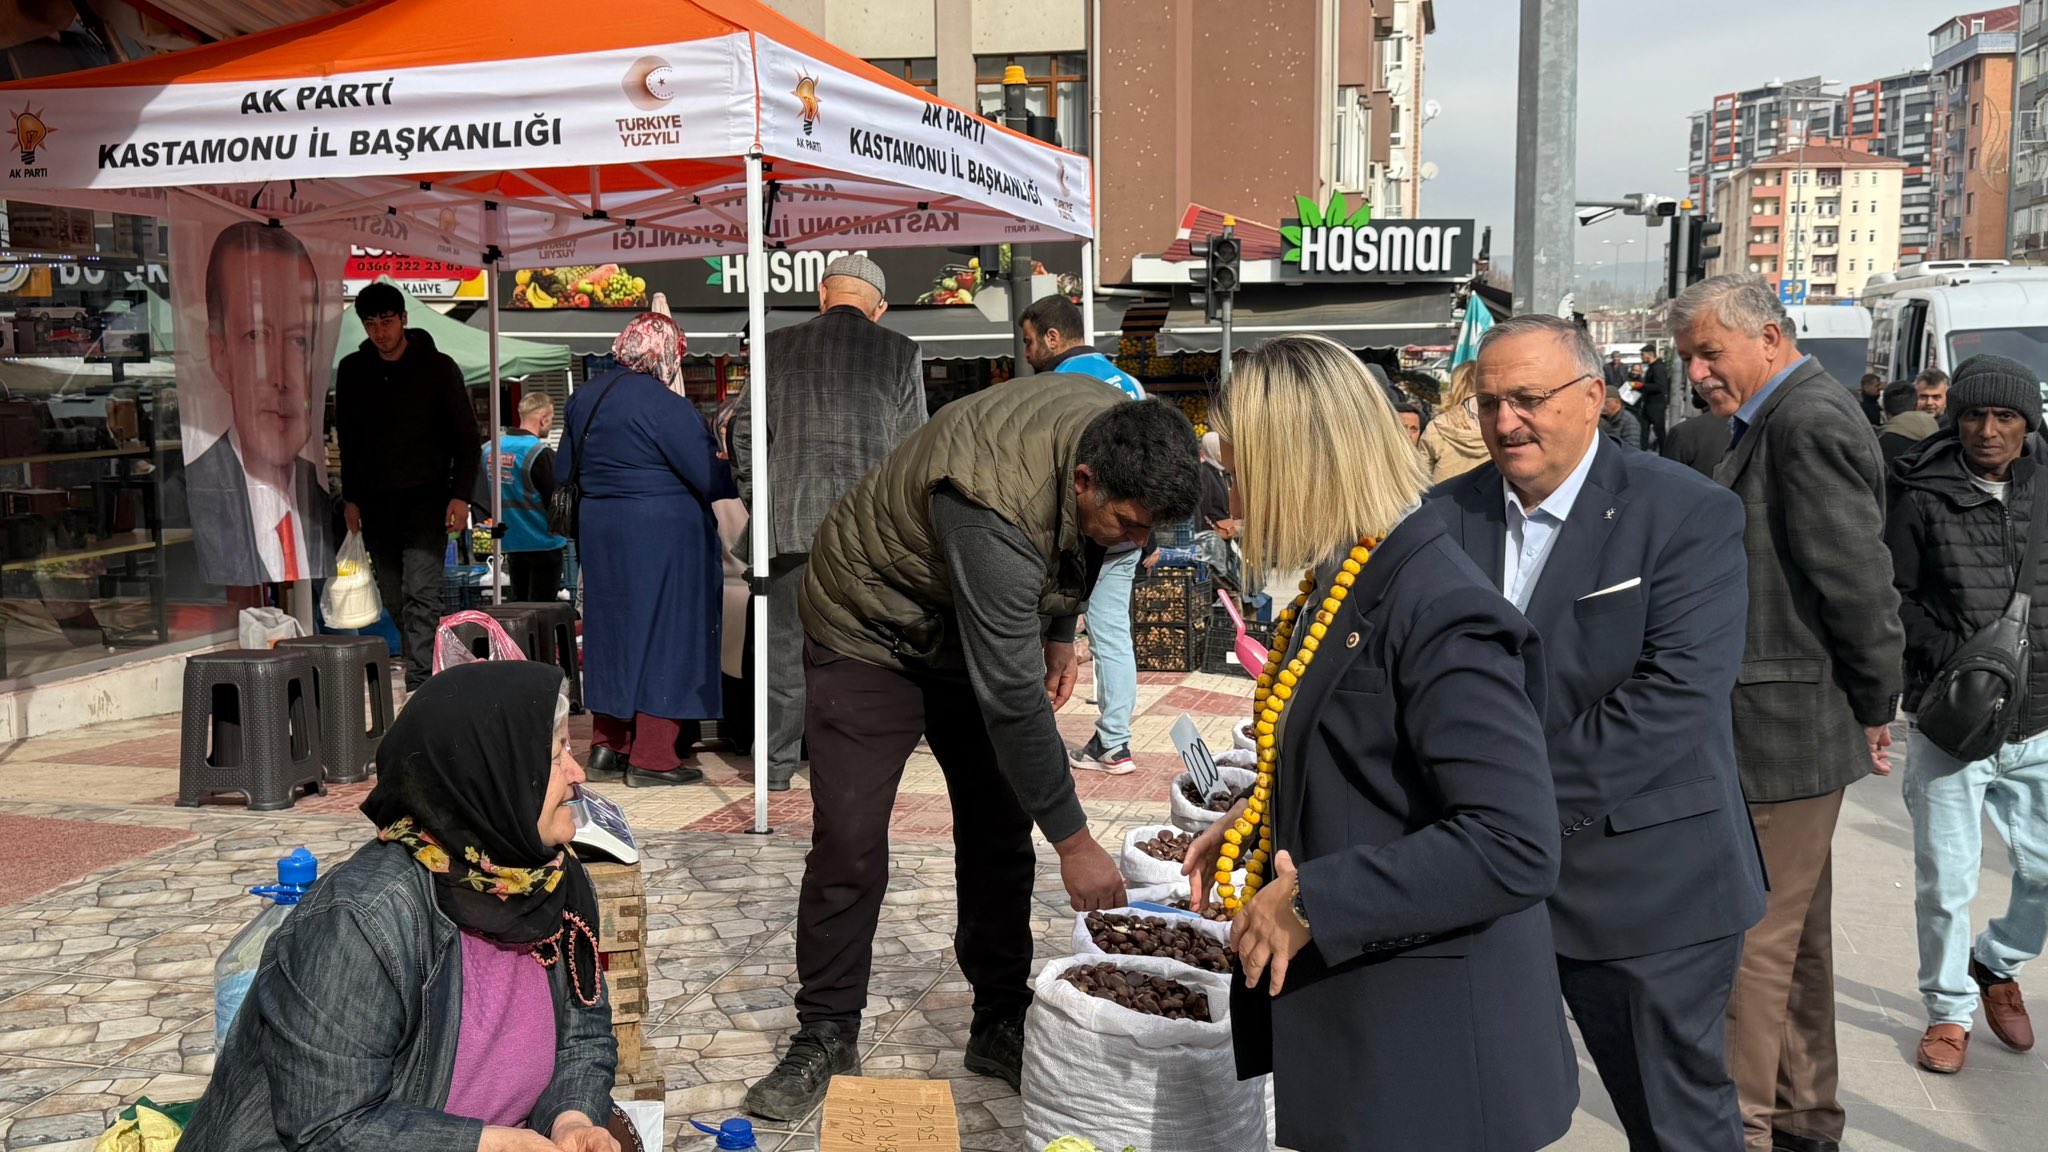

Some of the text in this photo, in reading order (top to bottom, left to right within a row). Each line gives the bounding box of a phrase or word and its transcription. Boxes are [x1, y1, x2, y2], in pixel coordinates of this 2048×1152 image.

[241, 77, 394, 115] AK PARTİ
[921, 102, 943, 130] AK
[98, 112, 562, 169] KASTAMONU İL BAŞKANLIĞI
[9, 169, 21, 178] AK
[850, 127, 1043, 206] KASTAMONU İL BAŞKANLIĞI
[356, 261, 391, 272] 0366
[395, 261, 421, 272] 222
[425, 261, 442, 272] 23
[1181, 737, 1219, 799] 200
